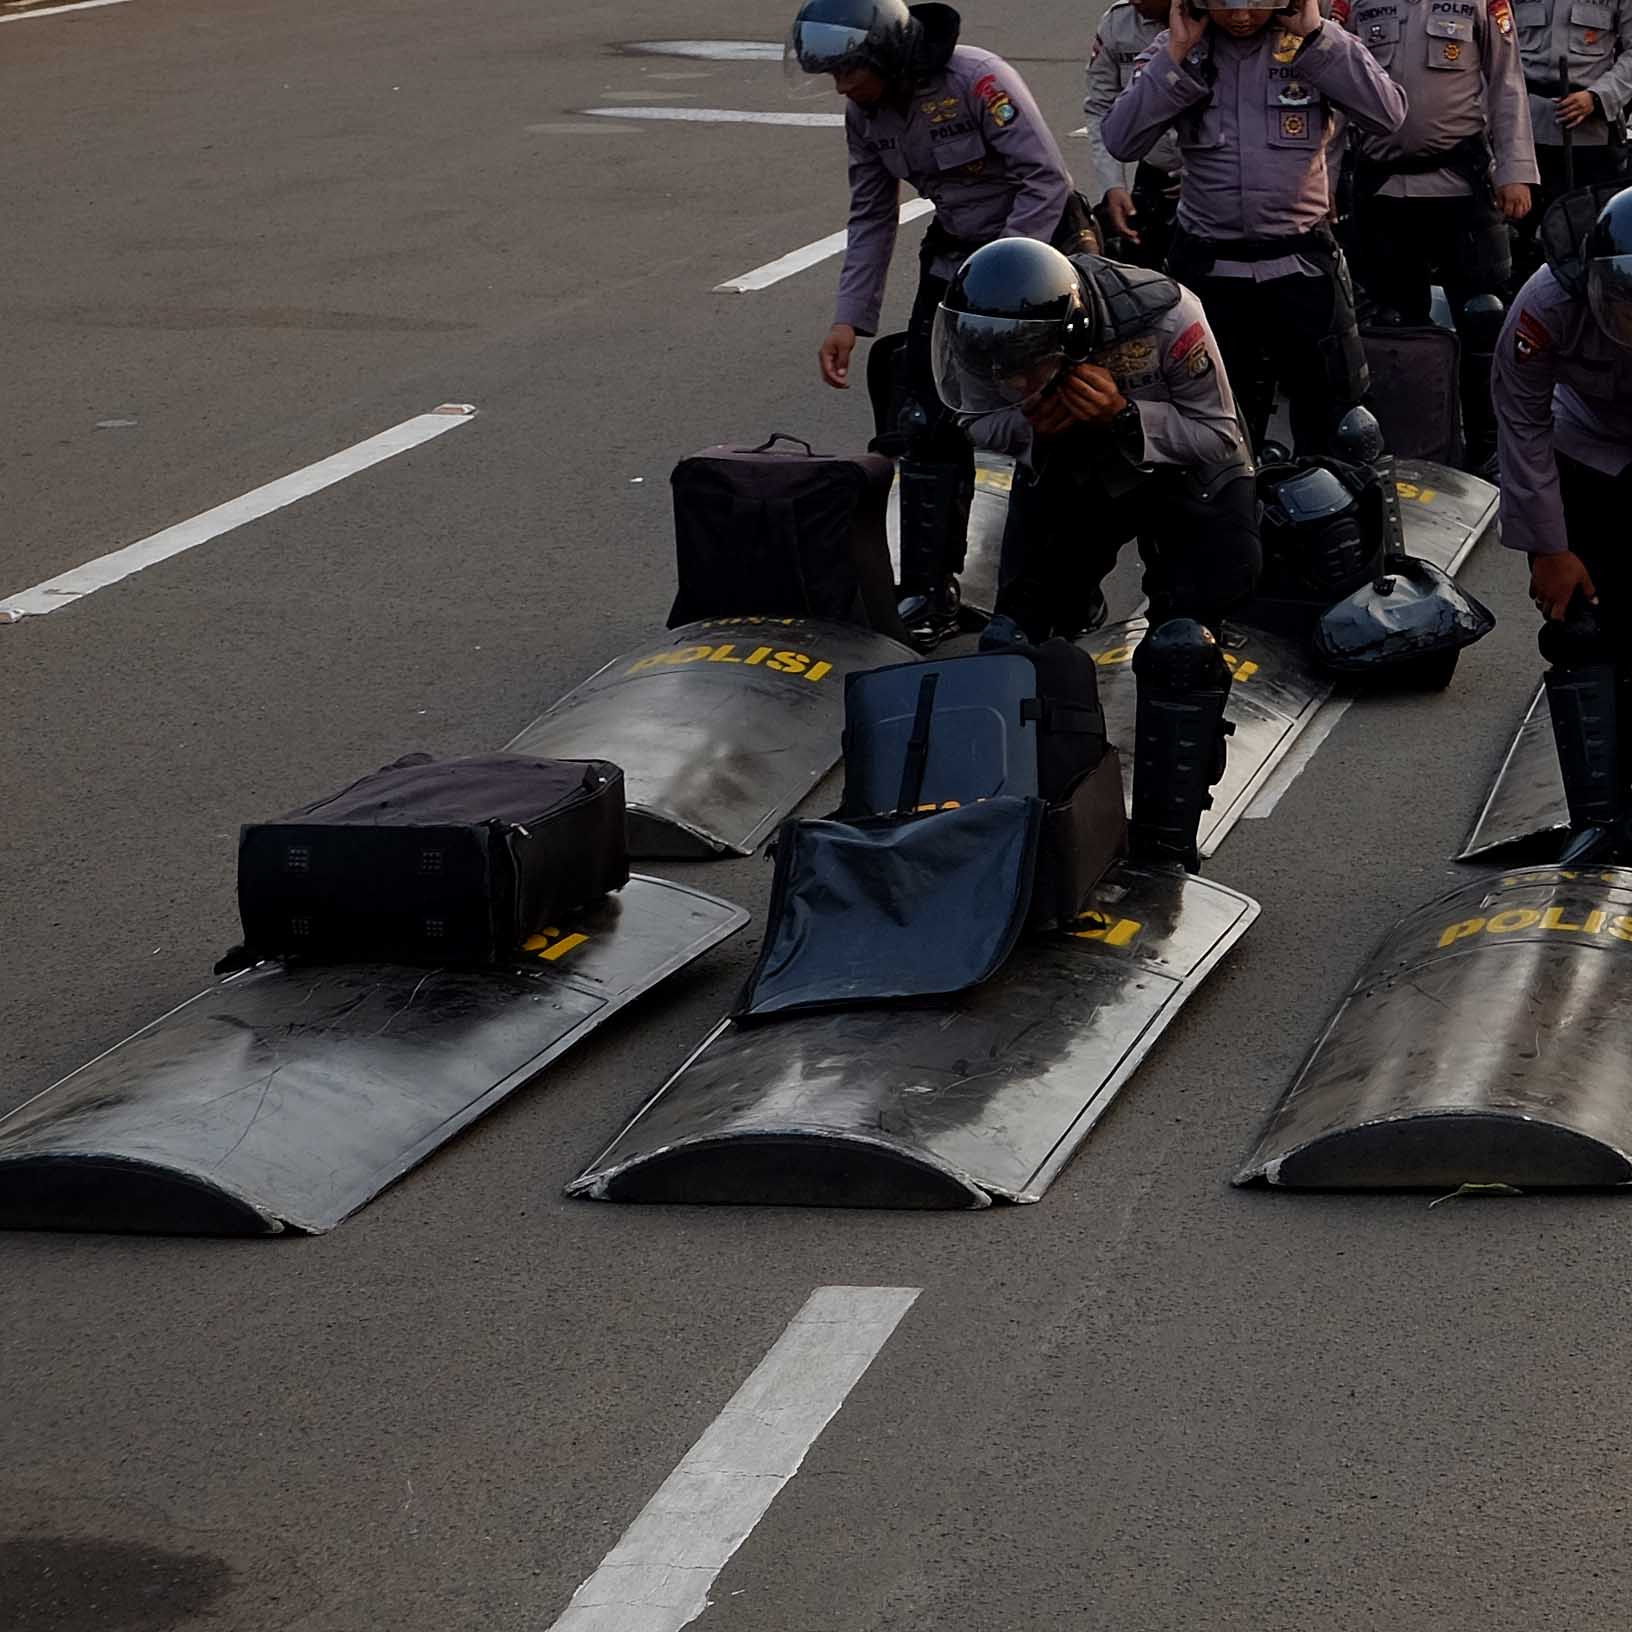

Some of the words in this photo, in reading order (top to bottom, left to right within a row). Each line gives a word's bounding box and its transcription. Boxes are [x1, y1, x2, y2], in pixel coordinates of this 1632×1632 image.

[1431, 2, 1475, 17] POLRI
[1268, 67, 1300, 79] POL
[627, 644, 833, 682] POLISI
